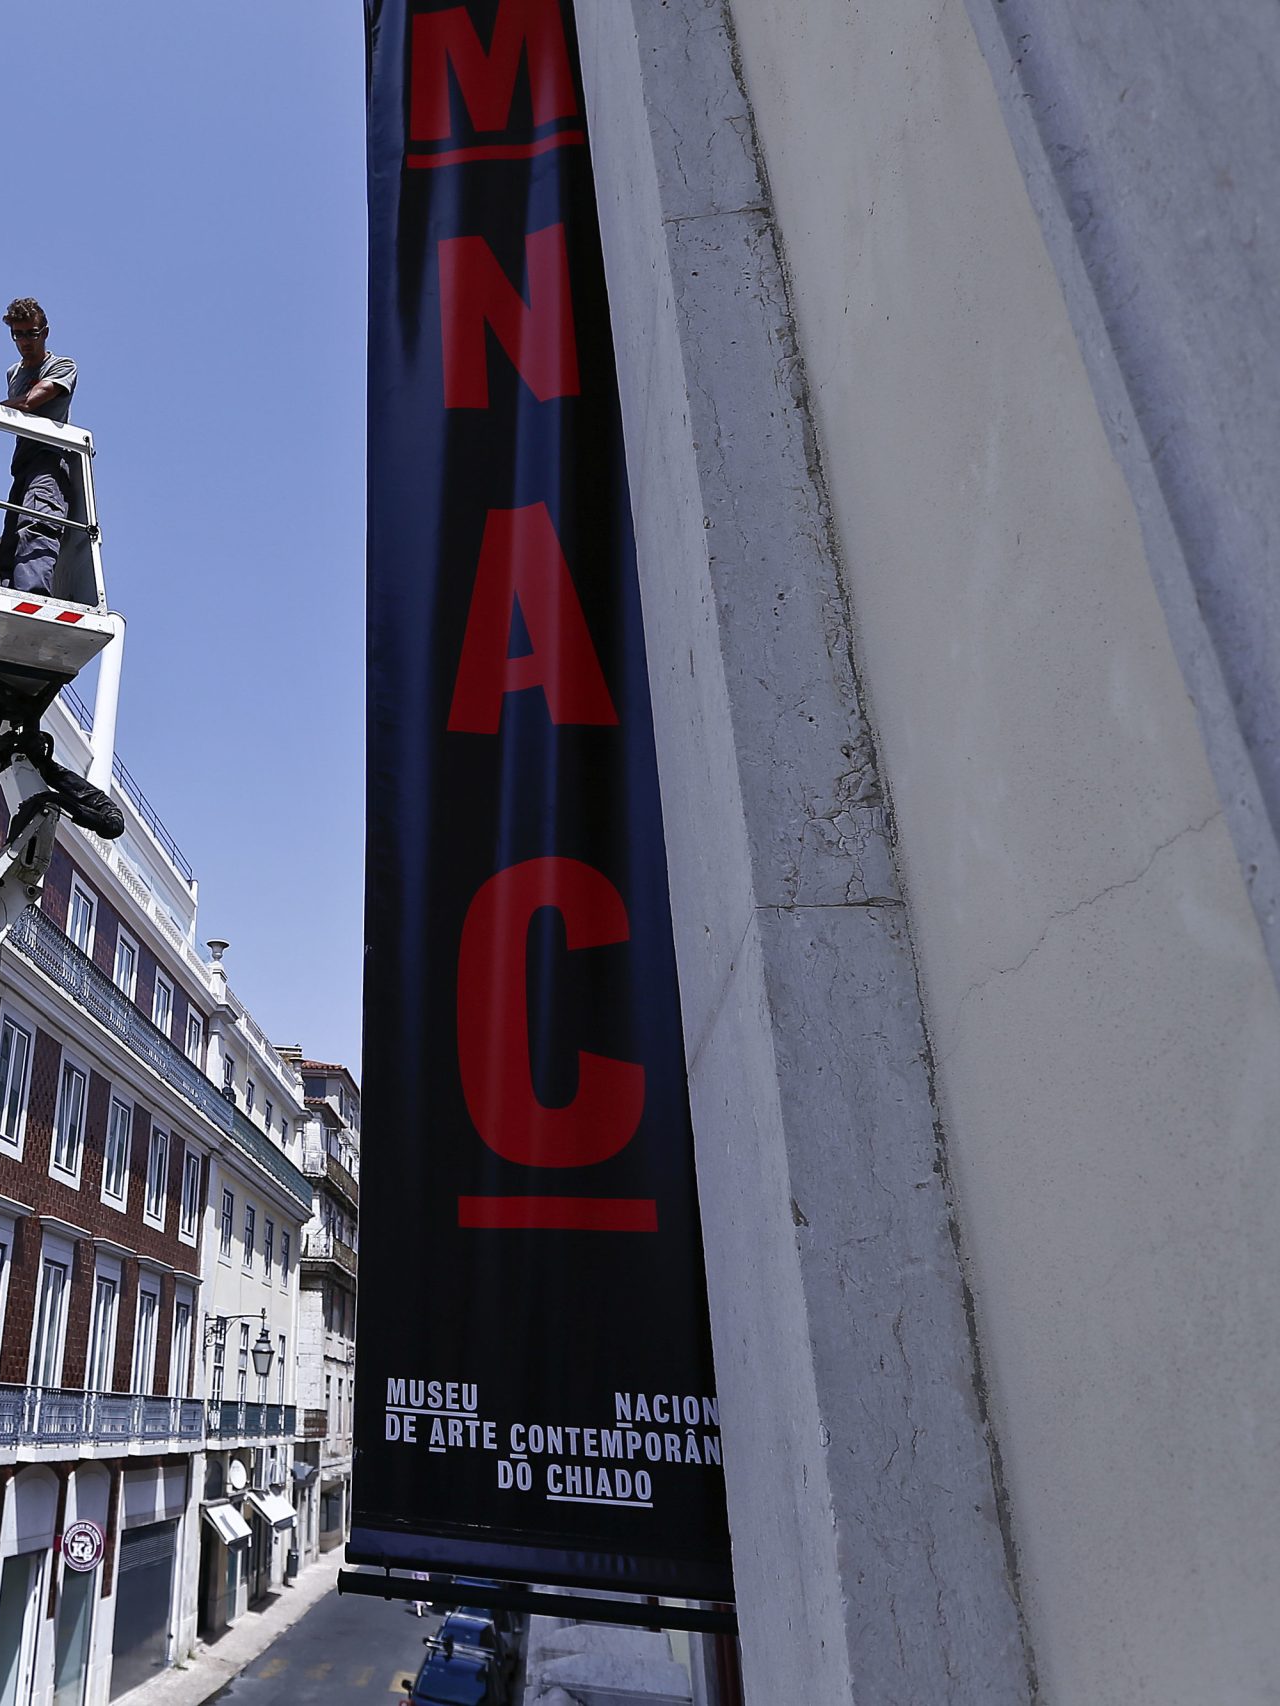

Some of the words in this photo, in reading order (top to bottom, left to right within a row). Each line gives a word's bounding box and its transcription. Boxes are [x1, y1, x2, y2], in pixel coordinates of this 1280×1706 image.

[386, 1377, 478, 1412] MUSEU
[615, 1392, 720, 1426] NACION
[385, 1413, 418, 1443] DE
[430, 1418, 497, 1450] ARTE
[510, 1423, 721, 1465] CONTEMPORÂN
[497, 1460, 532, 1491] DO
[547, 1464, 652, 1501] CHIADO
